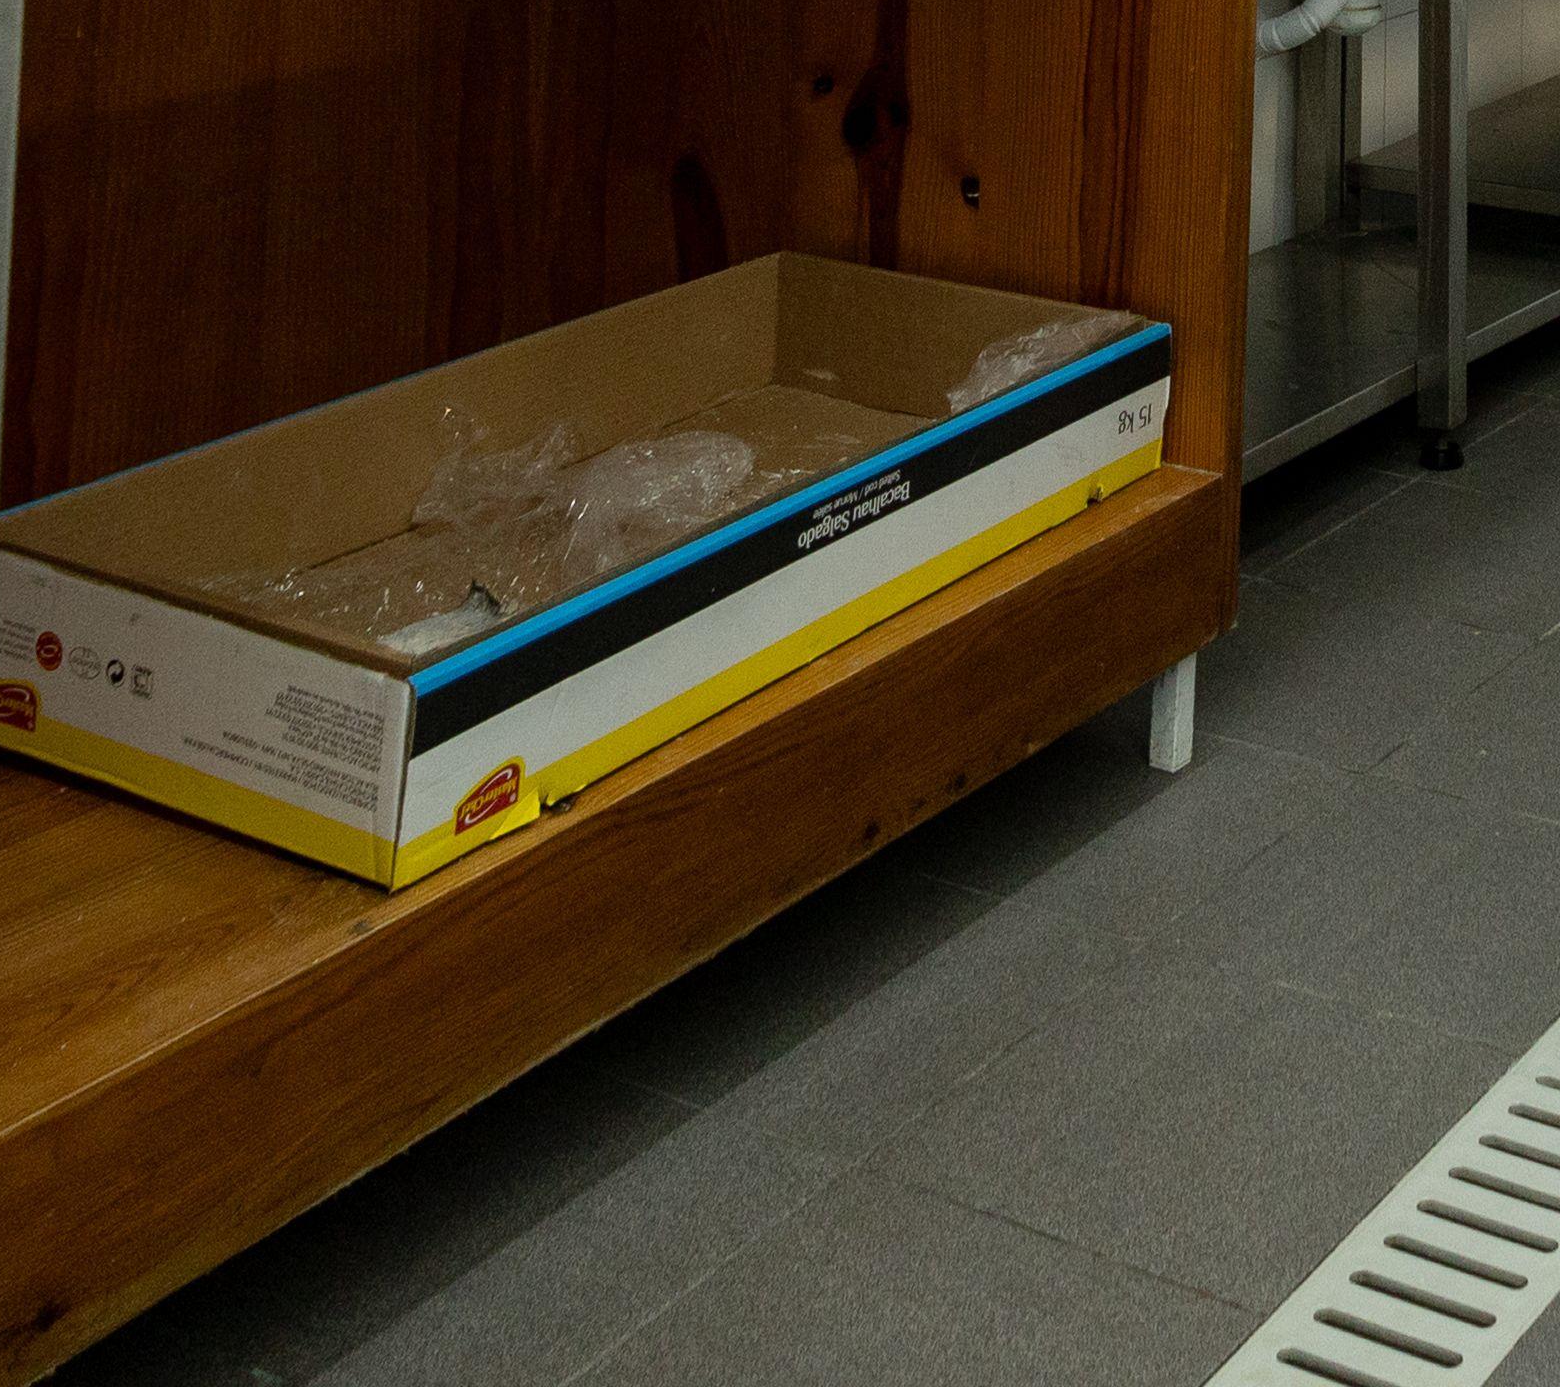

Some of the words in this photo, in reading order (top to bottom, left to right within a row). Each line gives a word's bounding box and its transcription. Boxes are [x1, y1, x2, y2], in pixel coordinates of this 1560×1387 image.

[1118, 410, 1135, 435] kg
[1139, 403, 1153, 430] 15
[852, 480, 911, 522] Bacalhau
[797, 510, 851, 549] Salgado
